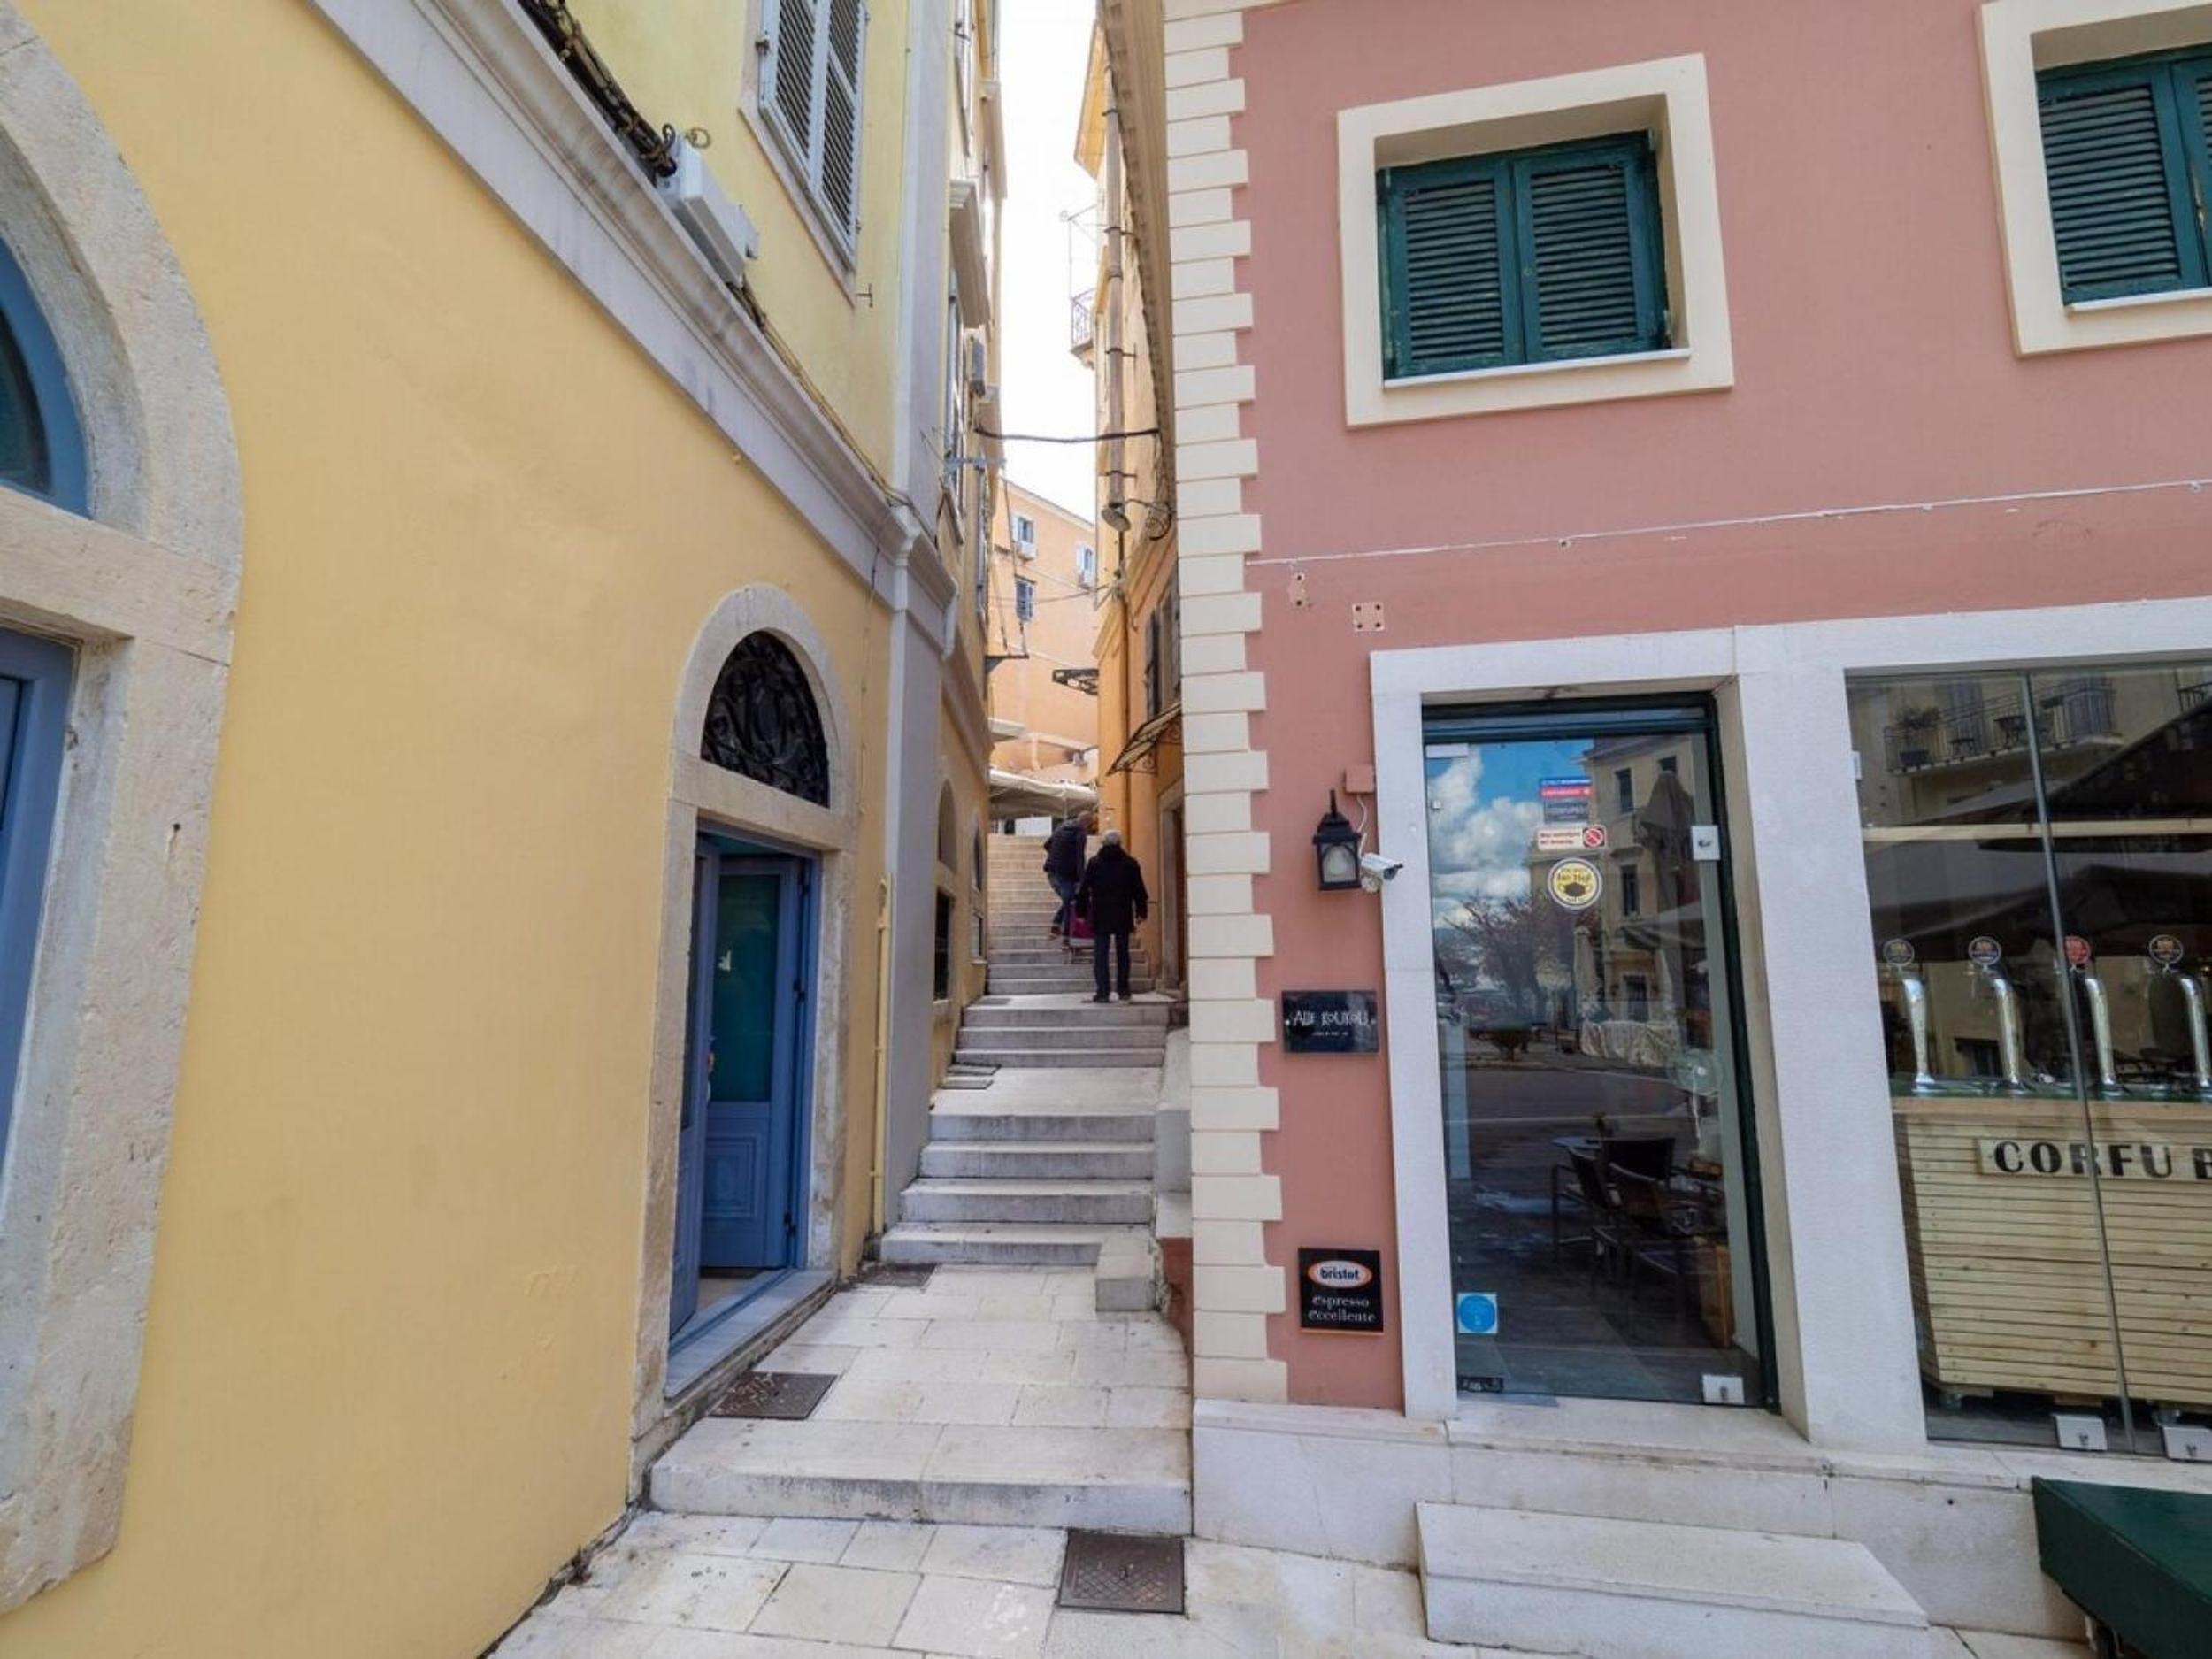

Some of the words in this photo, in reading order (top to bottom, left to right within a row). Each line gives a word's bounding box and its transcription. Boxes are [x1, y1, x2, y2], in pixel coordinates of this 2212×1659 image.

[1994, 1141, 2173, 1179] CORFU
[1311, 1295, 1370, 1310] espresso
[1308, 1309, 1376, 1323] eccellente
